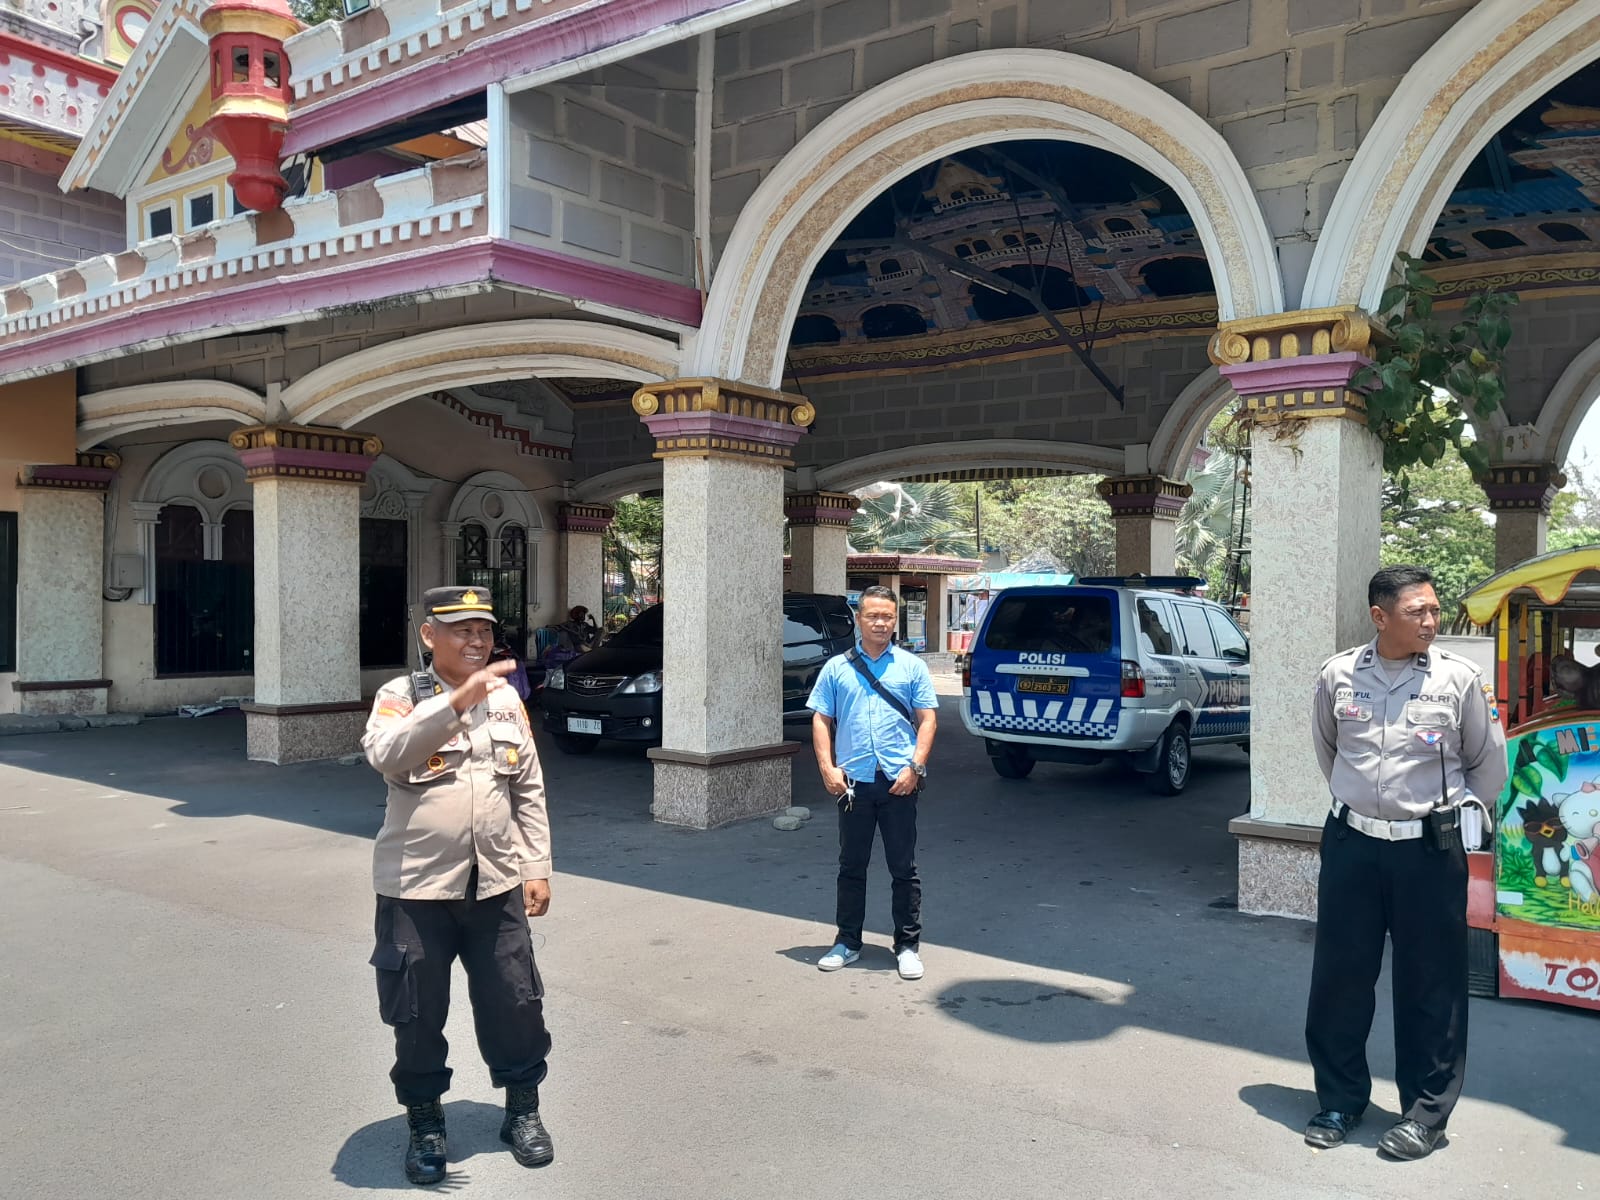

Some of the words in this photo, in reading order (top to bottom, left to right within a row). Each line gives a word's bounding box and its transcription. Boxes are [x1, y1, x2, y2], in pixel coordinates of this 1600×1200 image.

[1018, 652, 1066, 664] POLISI
[1208, 679, 1241, 704] POLISI
[1410, 693, 1450, 703] POLRI
[486, 711, 517, 721] POLRI
[1545, 963, 1600, 995] TO
